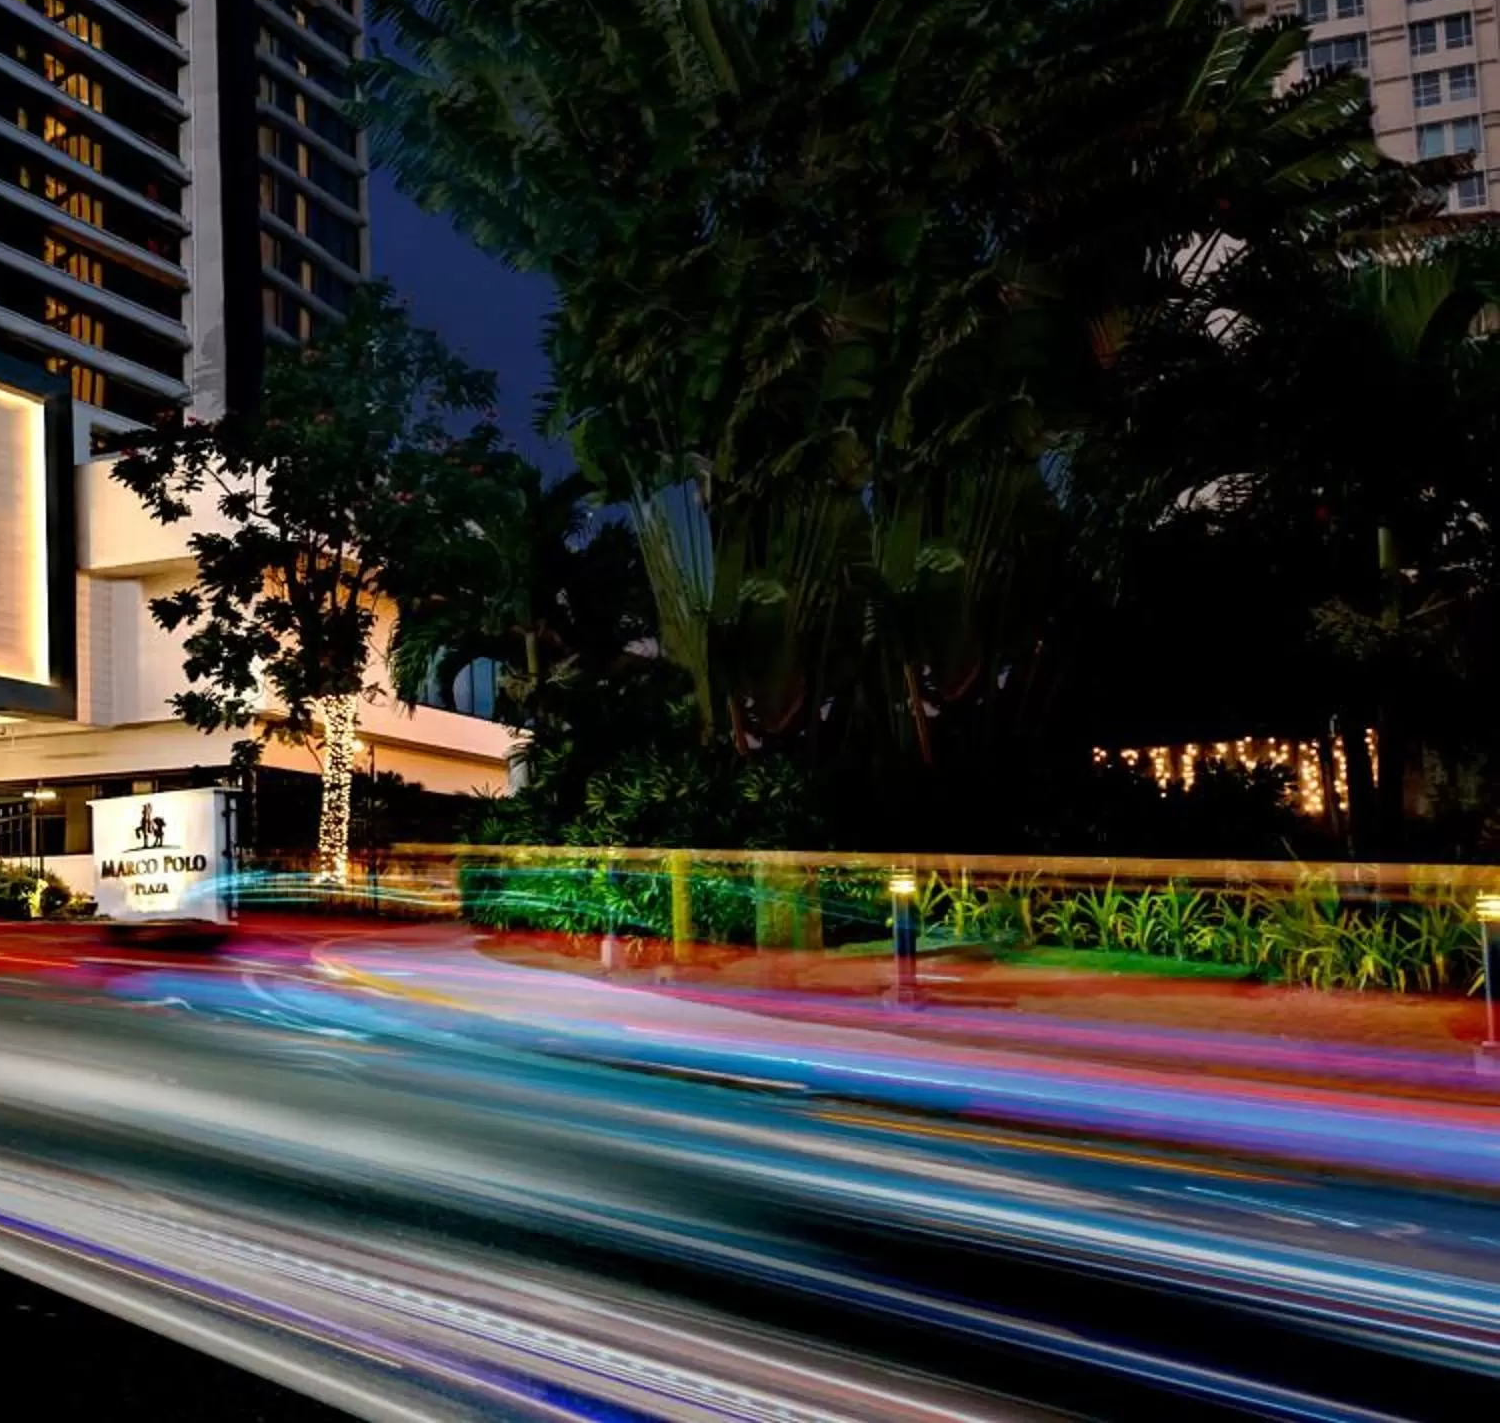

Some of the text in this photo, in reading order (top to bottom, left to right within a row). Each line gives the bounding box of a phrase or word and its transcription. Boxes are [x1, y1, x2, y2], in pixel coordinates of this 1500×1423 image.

[101, 854, 207, 879] MARCO POLO
[134, 882, 169, 895] PLAZA
